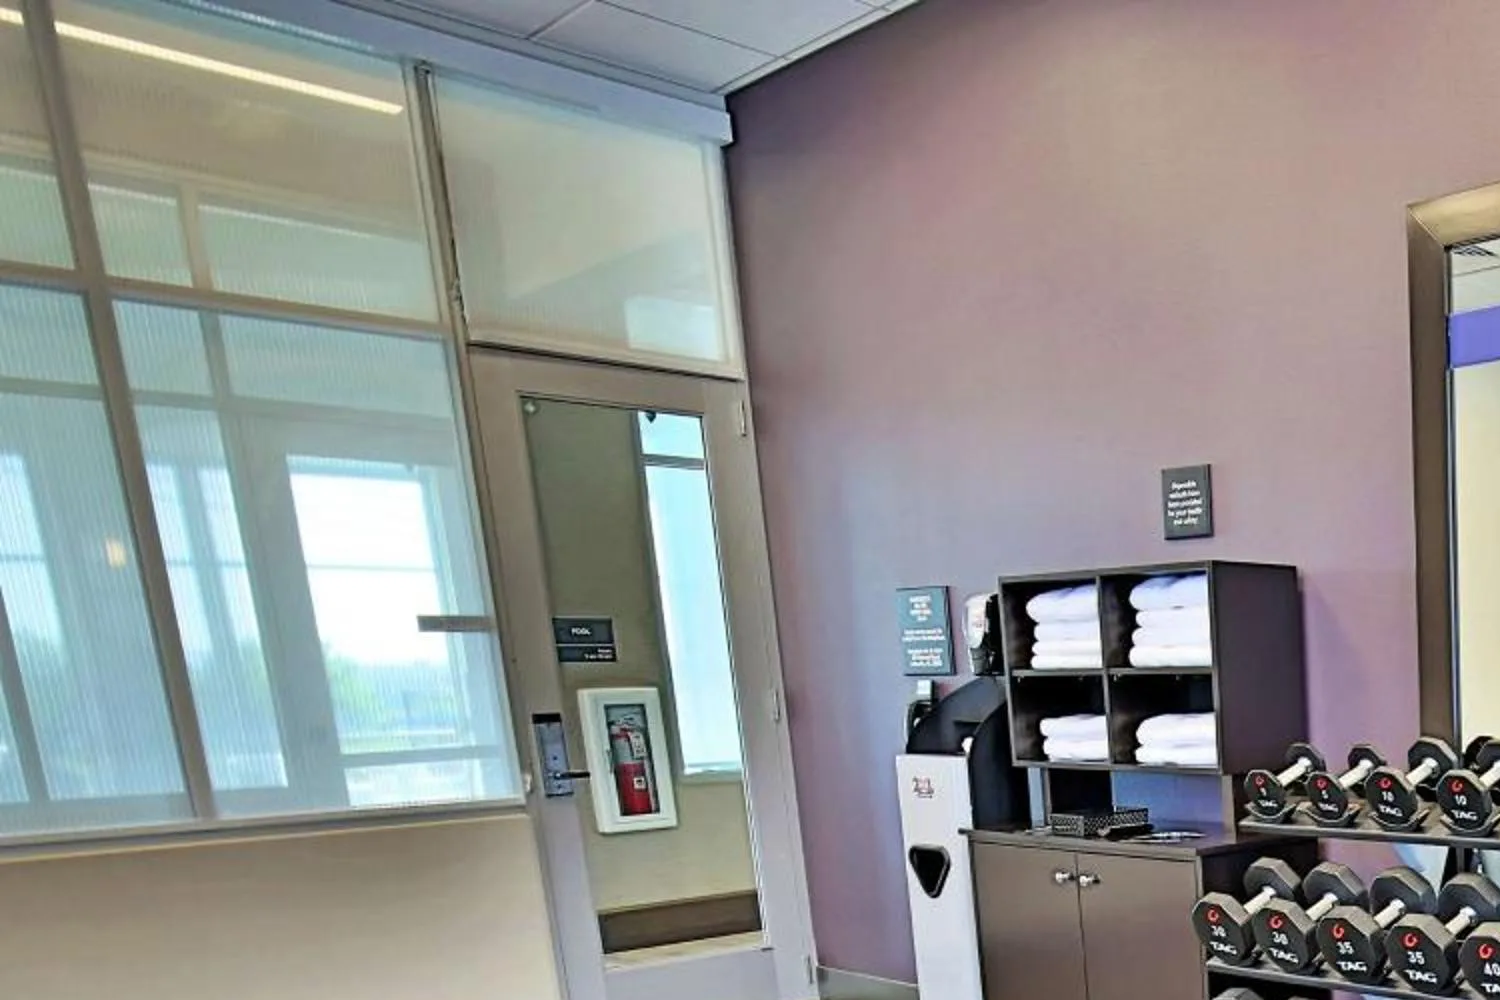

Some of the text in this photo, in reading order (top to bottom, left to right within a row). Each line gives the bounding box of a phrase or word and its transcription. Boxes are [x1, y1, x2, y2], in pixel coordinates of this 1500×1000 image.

[1451, 809, 1477, 820] TAG
[1272, 932, 1288, 945] 30
[1209, 941, 1237, 955] TAG
[1337, 942, 1353, 955] 35
[1270, 948, 1299, 964] TAG
[1407, 951, 1425, 966] 35
[1336, 961, 1368, 972] TAG
[1483, 963, 1500, 976] 40
[1404, 970, 1438, 984] TAG
